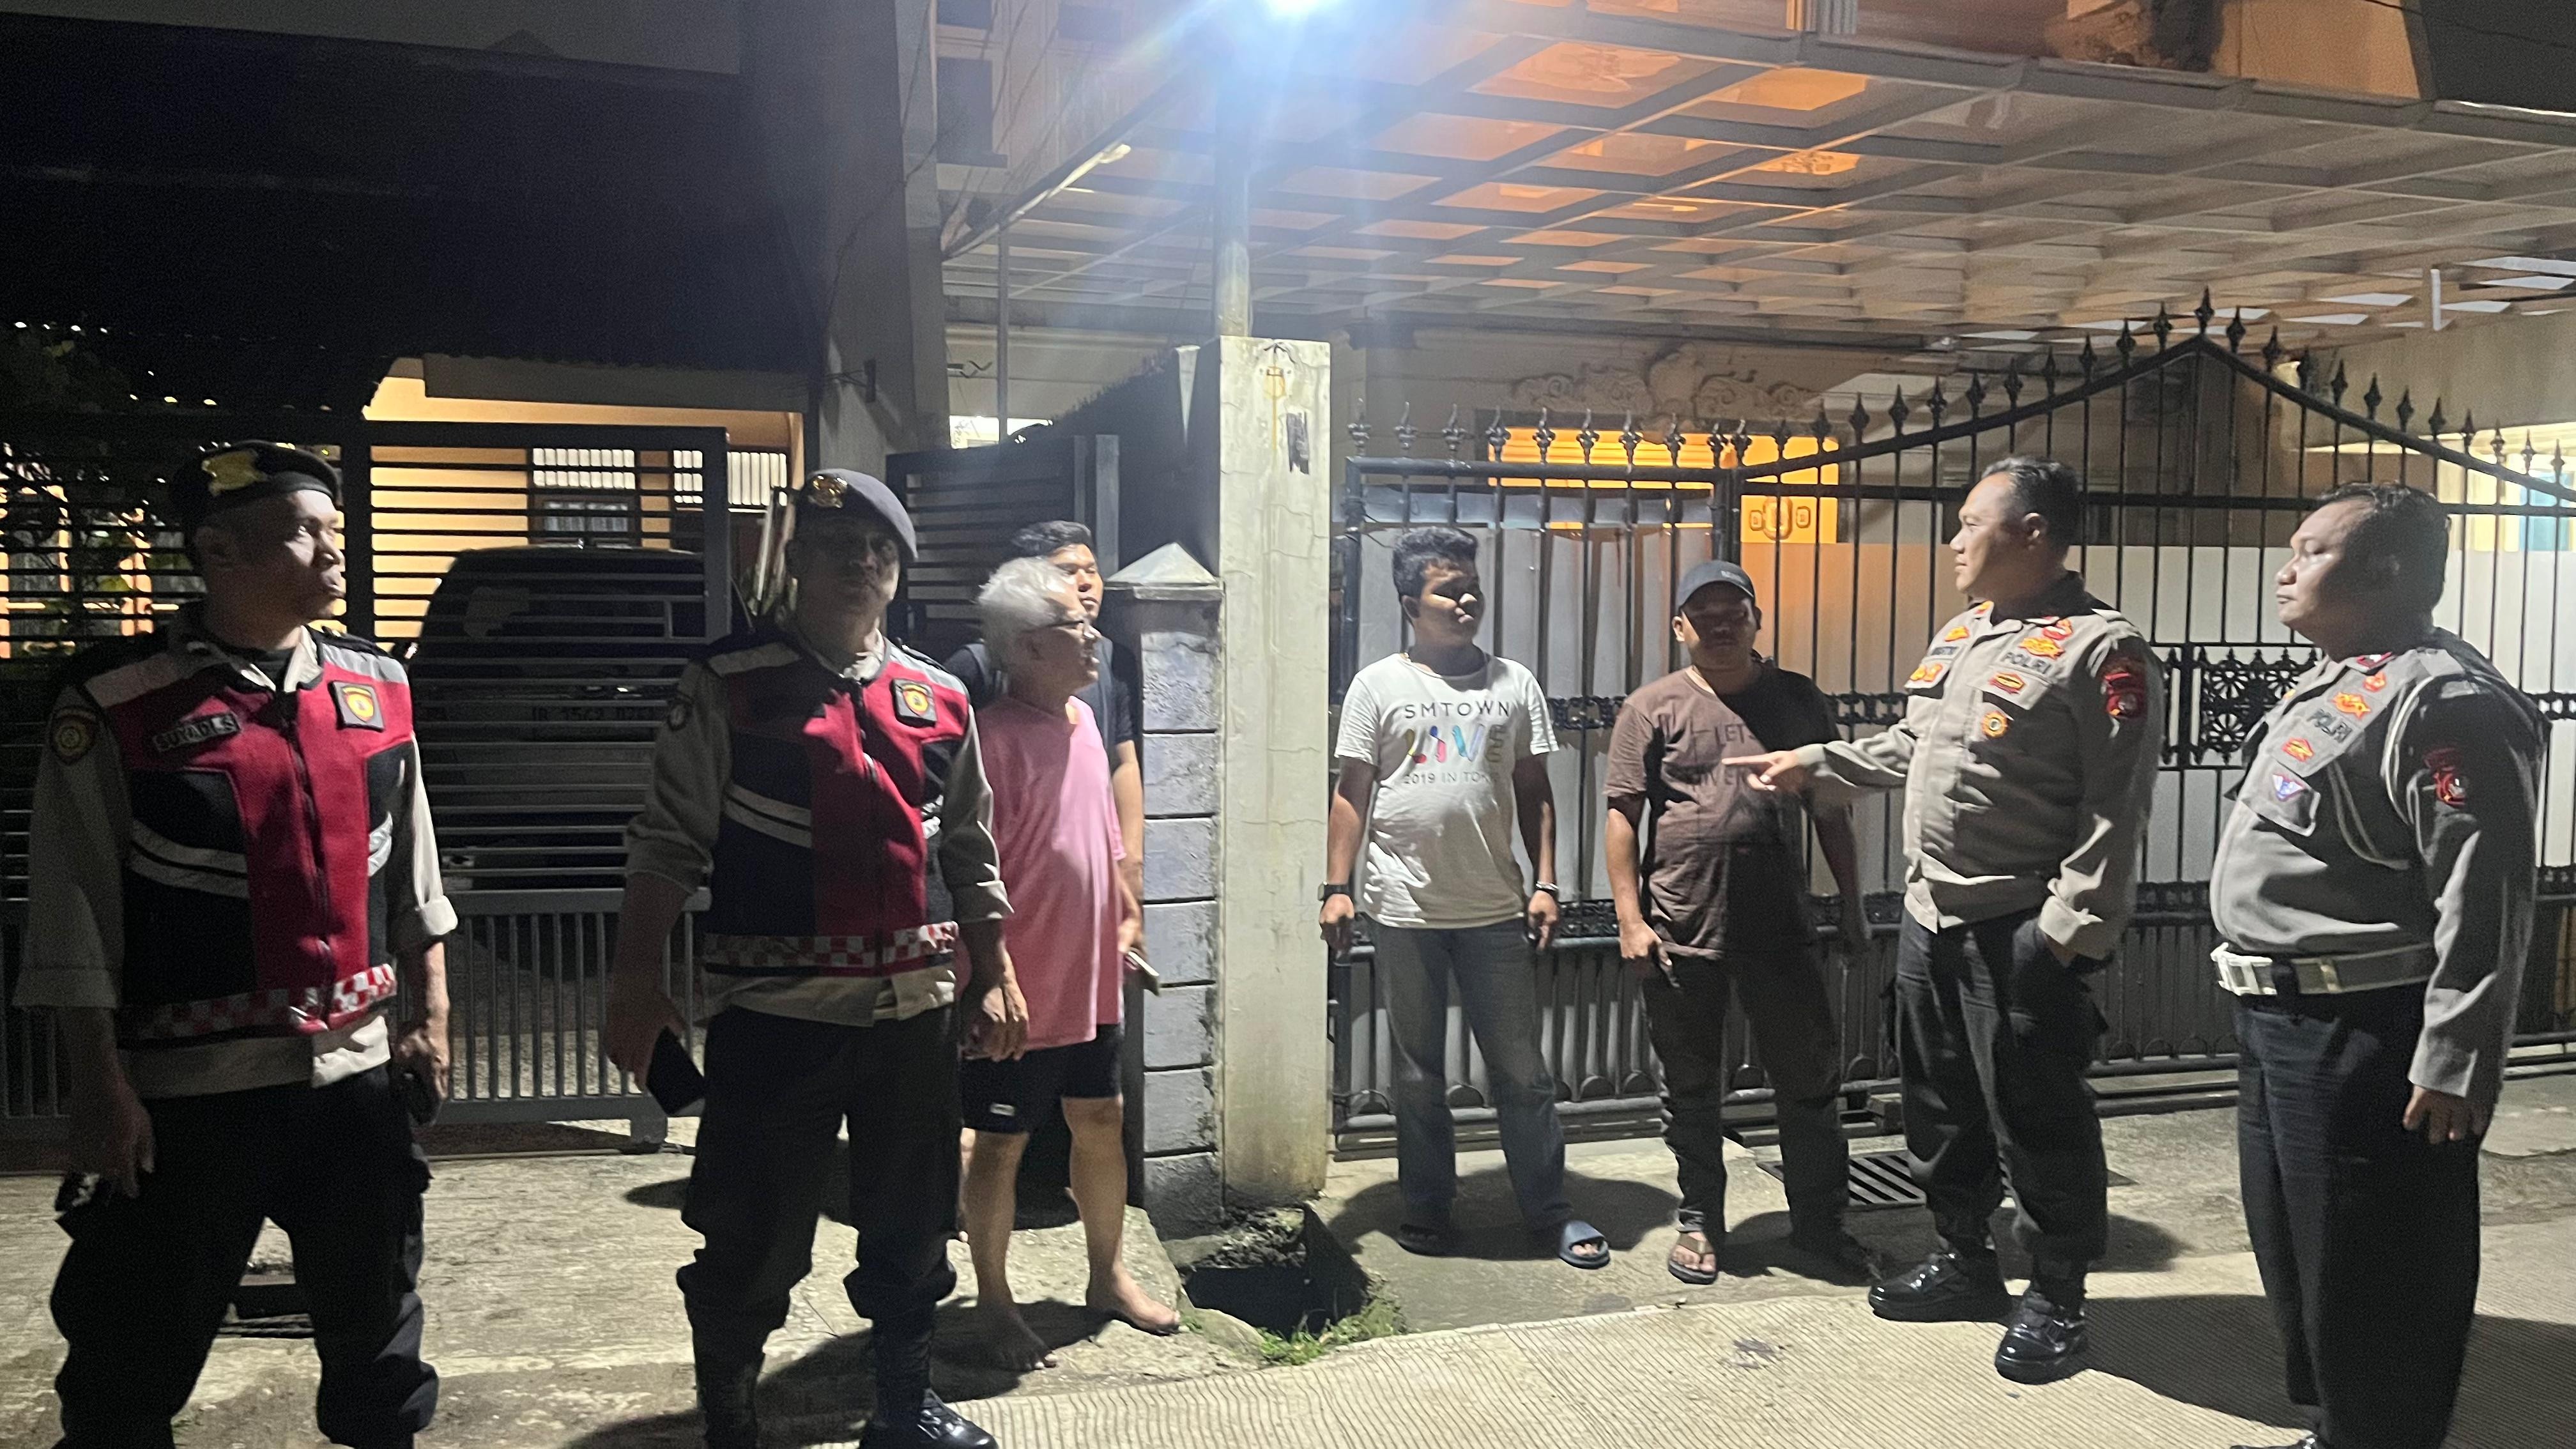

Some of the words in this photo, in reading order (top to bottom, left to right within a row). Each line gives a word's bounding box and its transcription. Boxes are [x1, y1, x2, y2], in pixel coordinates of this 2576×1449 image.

[2000, 651, 2051, 675] POLRI
[1404, 700, 1510, 719] SMTOWN
[2306, 708, 2353, 744] POLRI
[1403, 772, 1436, 785] 2019
[1441, 771, 1457, 783] IN
